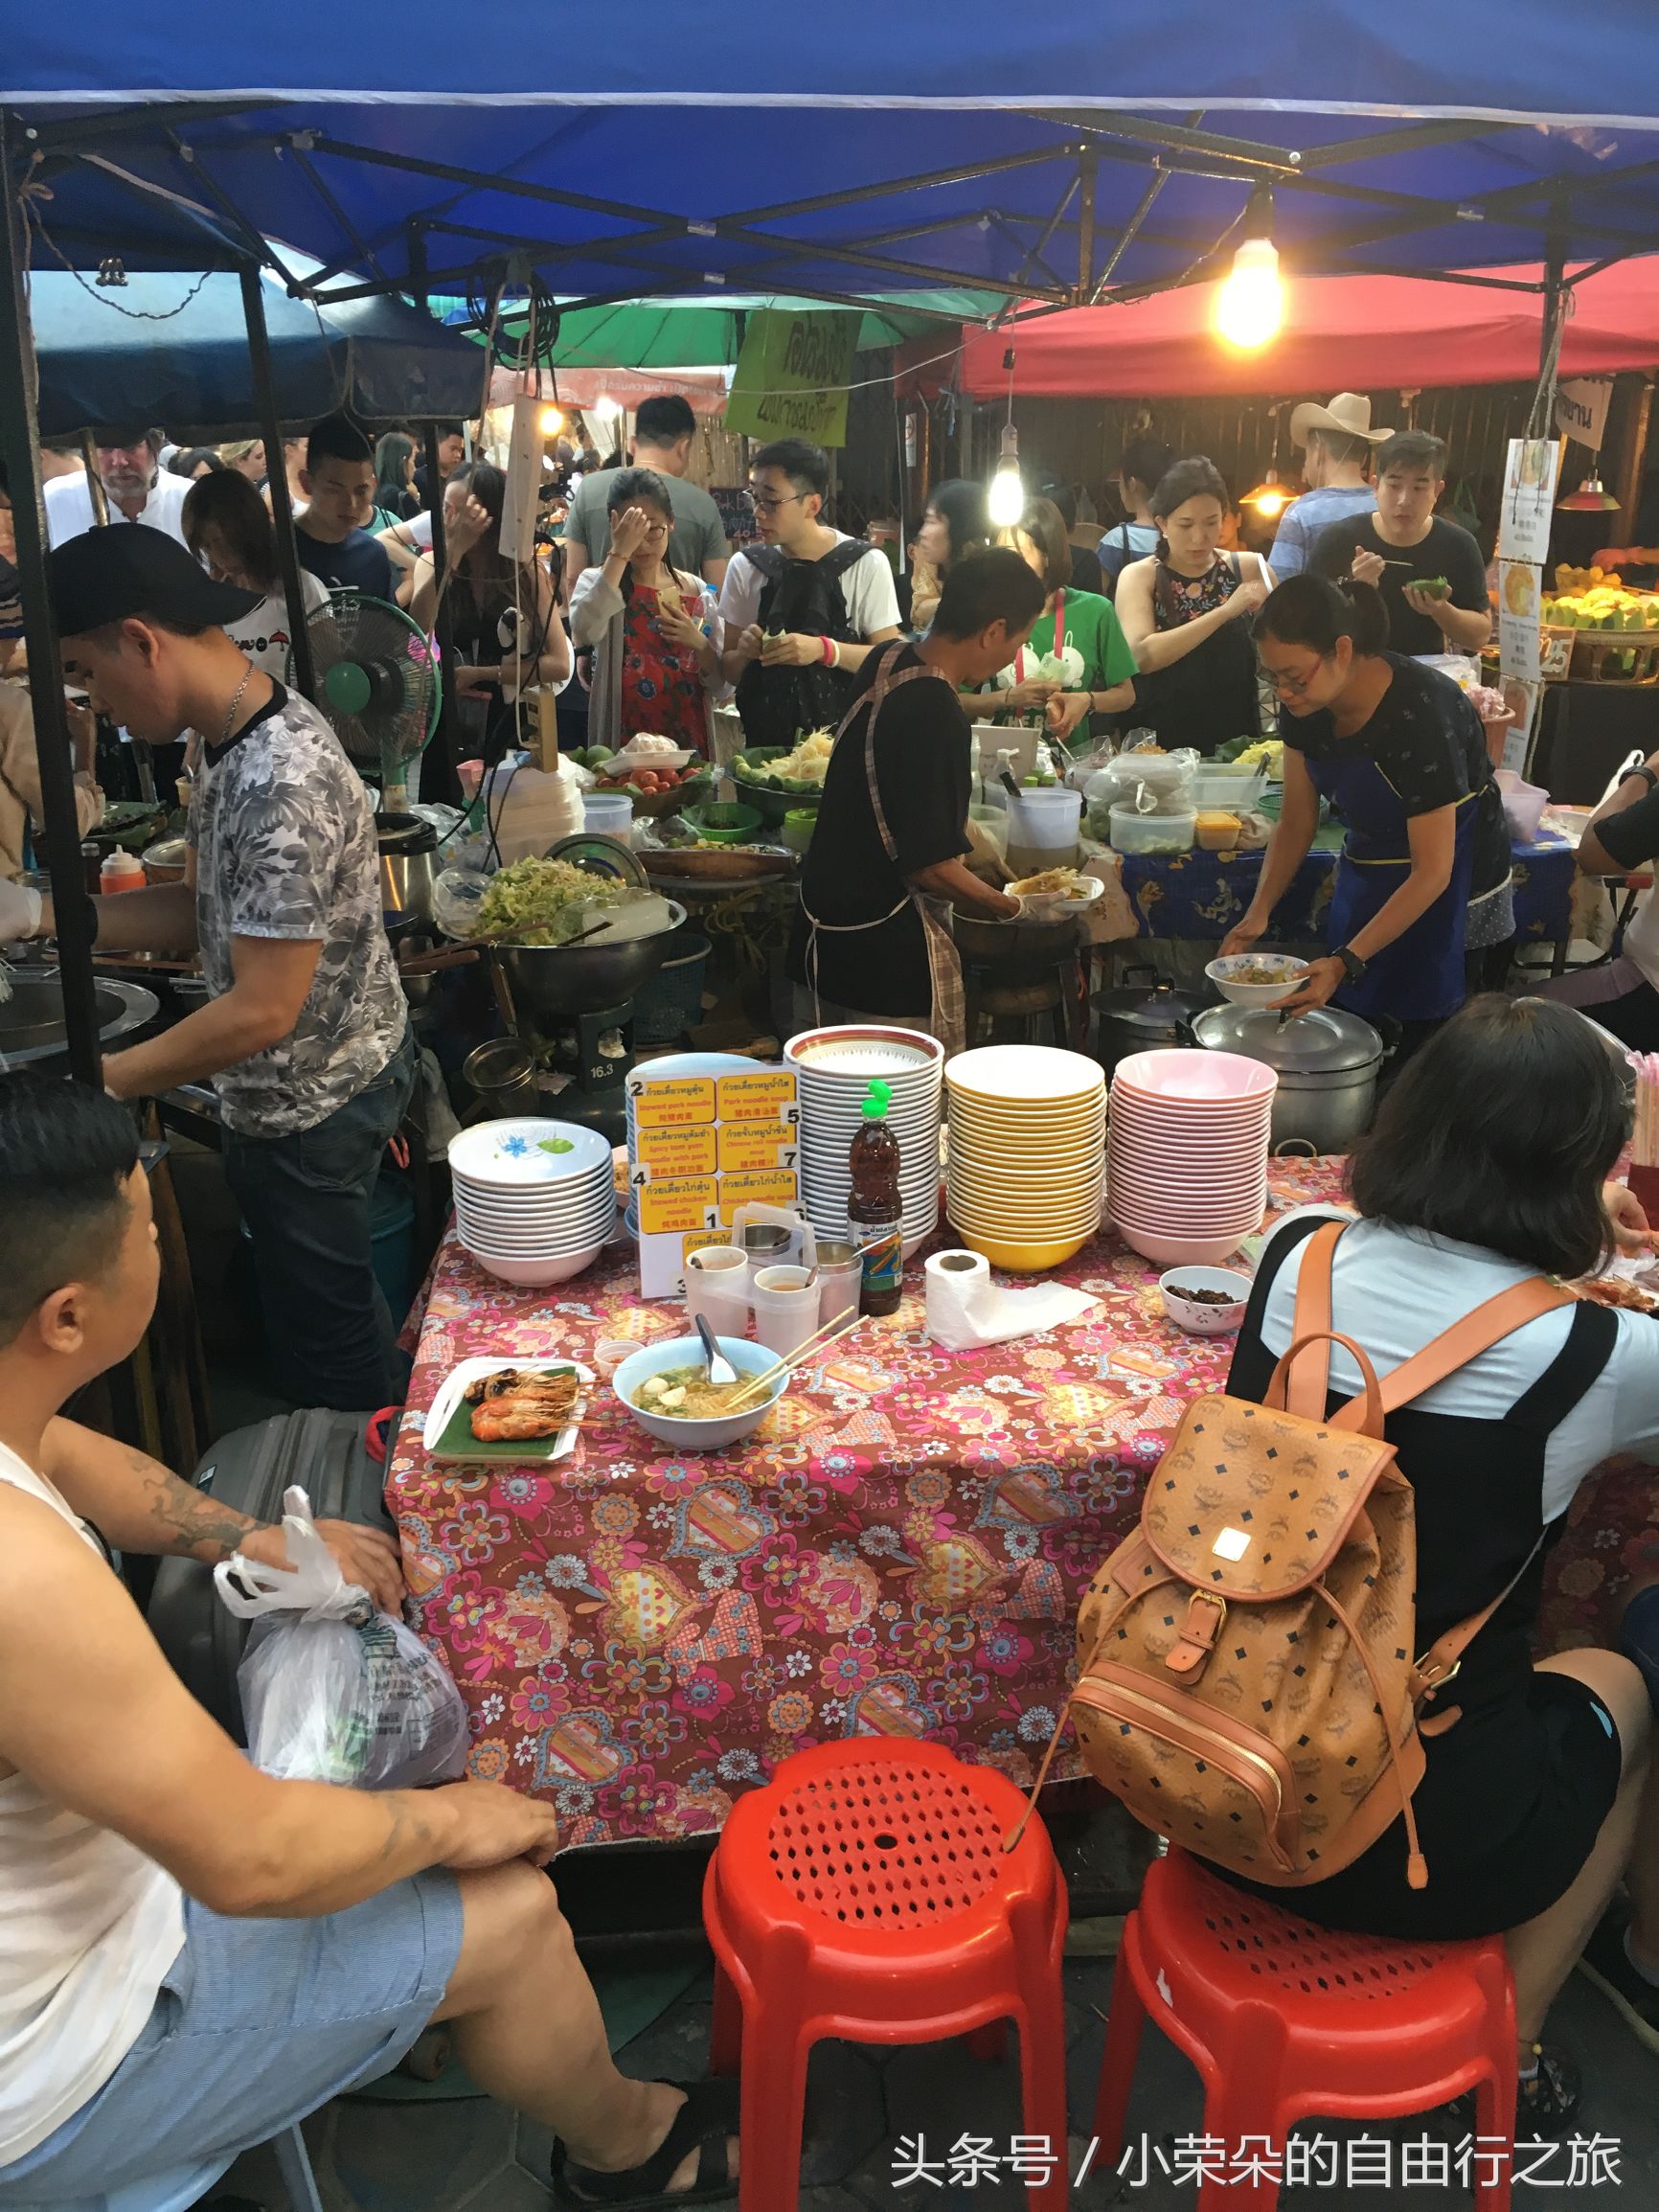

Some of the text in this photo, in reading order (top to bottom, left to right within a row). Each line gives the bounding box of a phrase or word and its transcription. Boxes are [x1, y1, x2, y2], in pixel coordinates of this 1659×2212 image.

[590, 1063, 614, 1079] 16.3
[630, 1081, 644, 1097] 2
[787, 1108, 800, 1124] 5
[784, 1152, 797, 1167] 7
[632, 1171, 647, 1186] 4
[706, 1213, 716, 1228] 1
